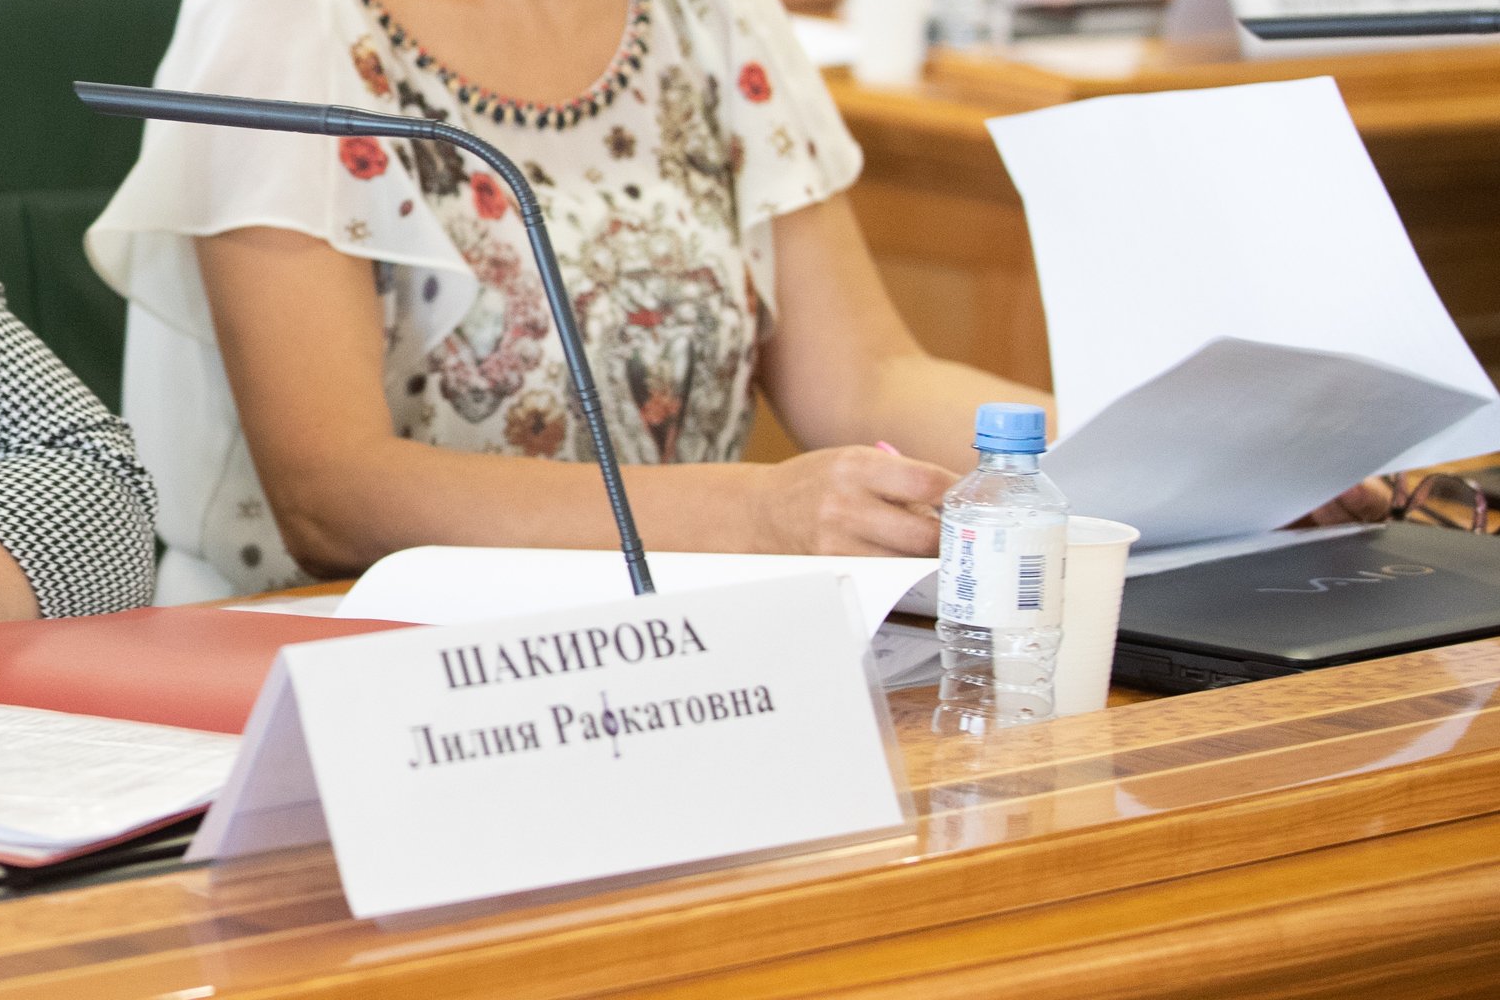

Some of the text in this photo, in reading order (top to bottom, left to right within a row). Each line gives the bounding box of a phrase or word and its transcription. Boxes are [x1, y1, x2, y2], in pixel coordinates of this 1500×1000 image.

[439, 615, 707, 690] ШАКИРОВА
[409, 684, 775, 769] Лилия Рафкатовна
